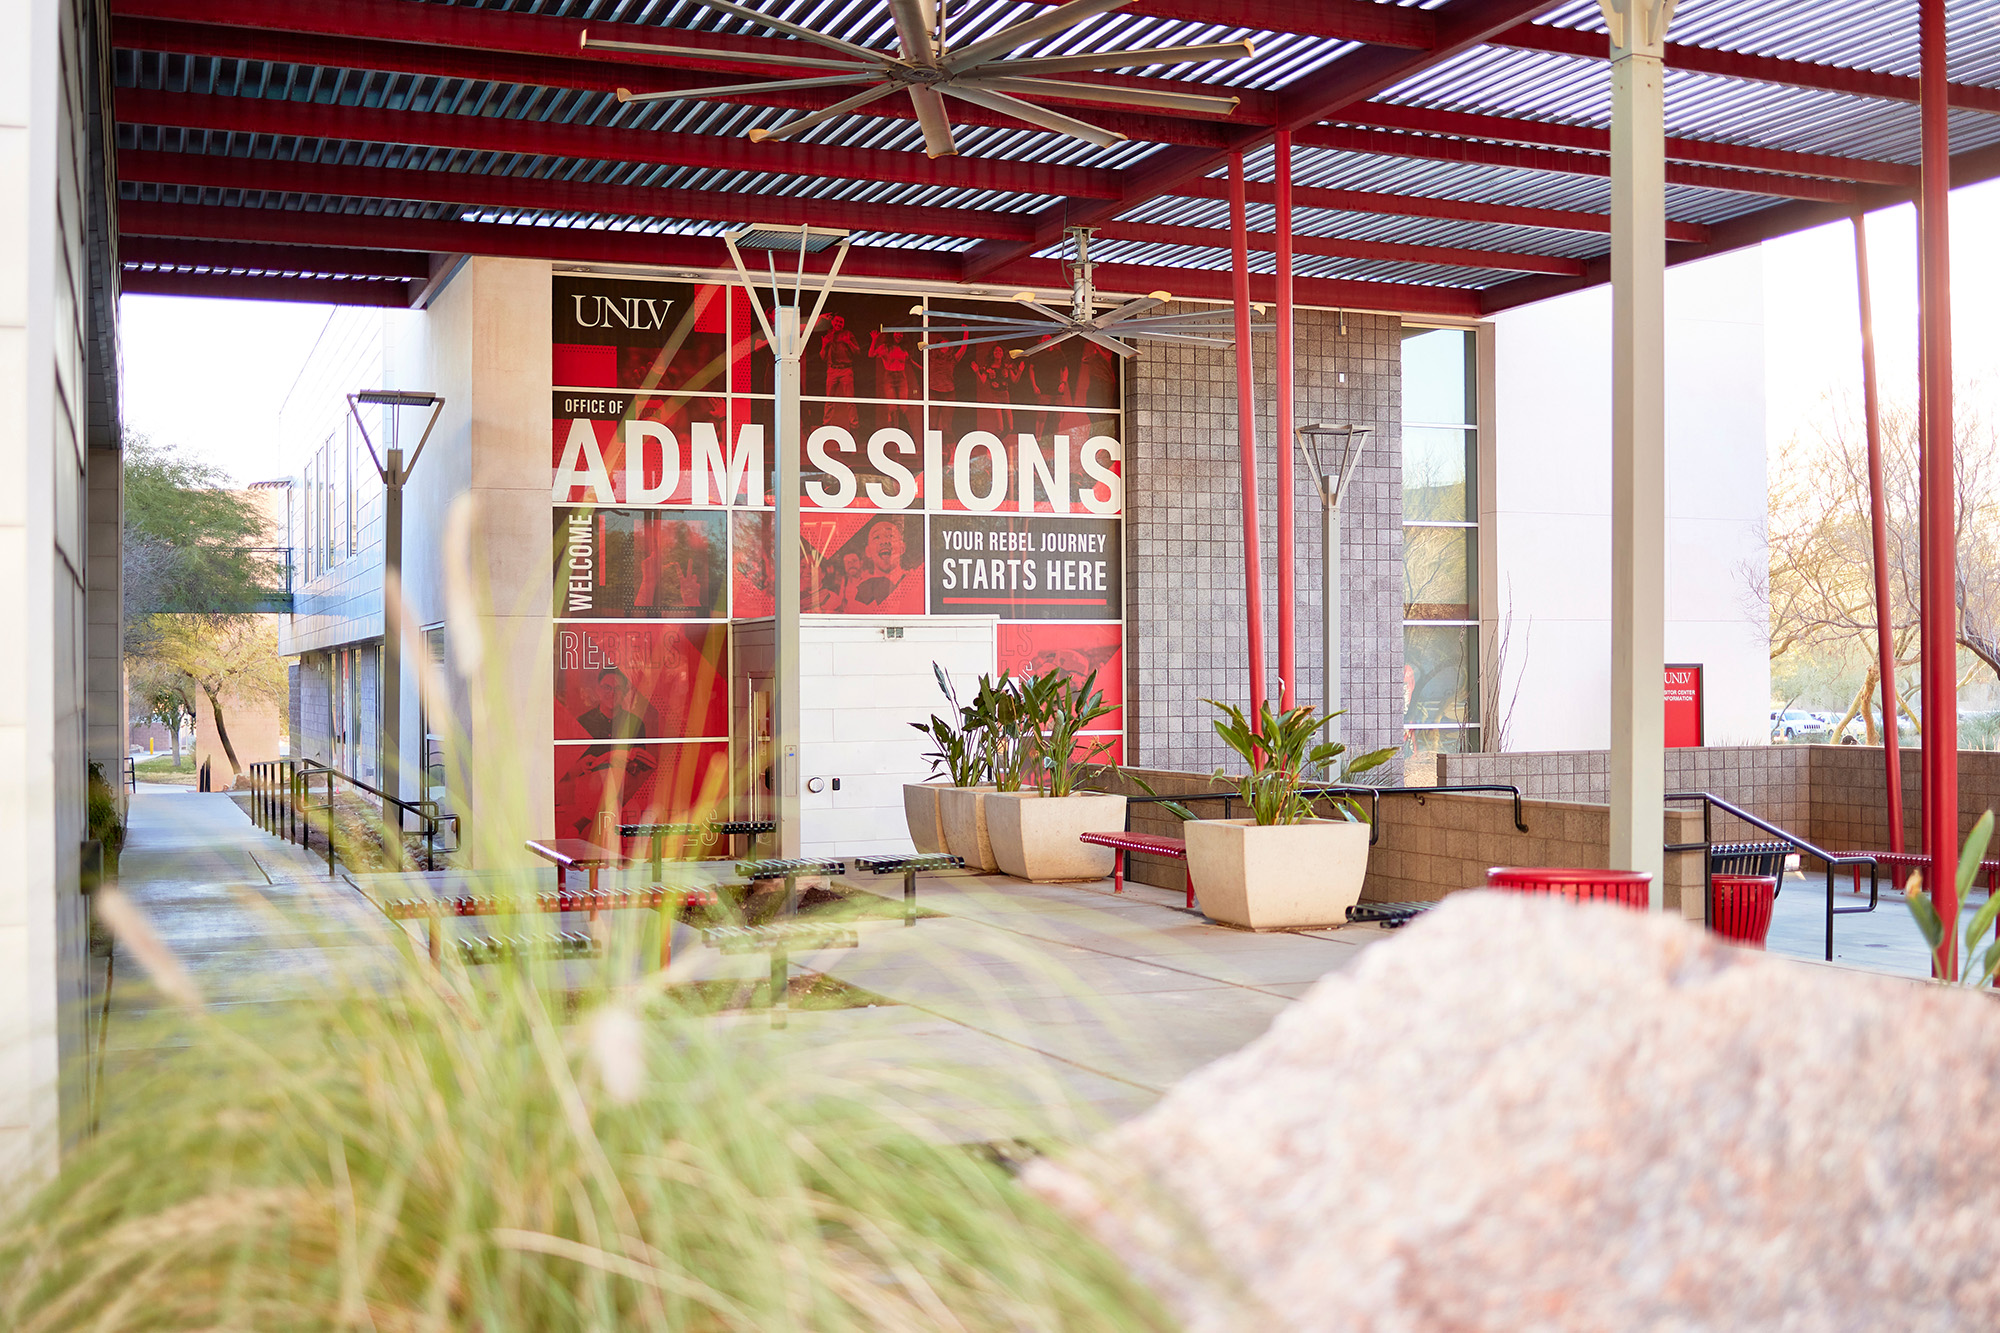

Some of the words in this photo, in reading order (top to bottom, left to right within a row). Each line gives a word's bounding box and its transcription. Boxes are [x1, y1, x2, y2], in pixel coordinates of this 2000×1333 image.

[571, 294, 675, 331] UNLV
[565, 398, 605, 414] OFFICE
[608, 400, 624, 415] OF
[552, 417, 1122, 515] ADMSSIONS
[942, 530, 984, 551] YOUR
[989, 531, 1036, 552] REBEL
[1040, 532, 1107, 553] JOURNEY
[568, 514, 593, 612] WELCOME
[942, 557, 1037, 591] STARTS
[1046, 560, 1108, 591] HERE
[559, 630, 681, 670] REBELS
[1664, 672, 1691, 684] UNLV
